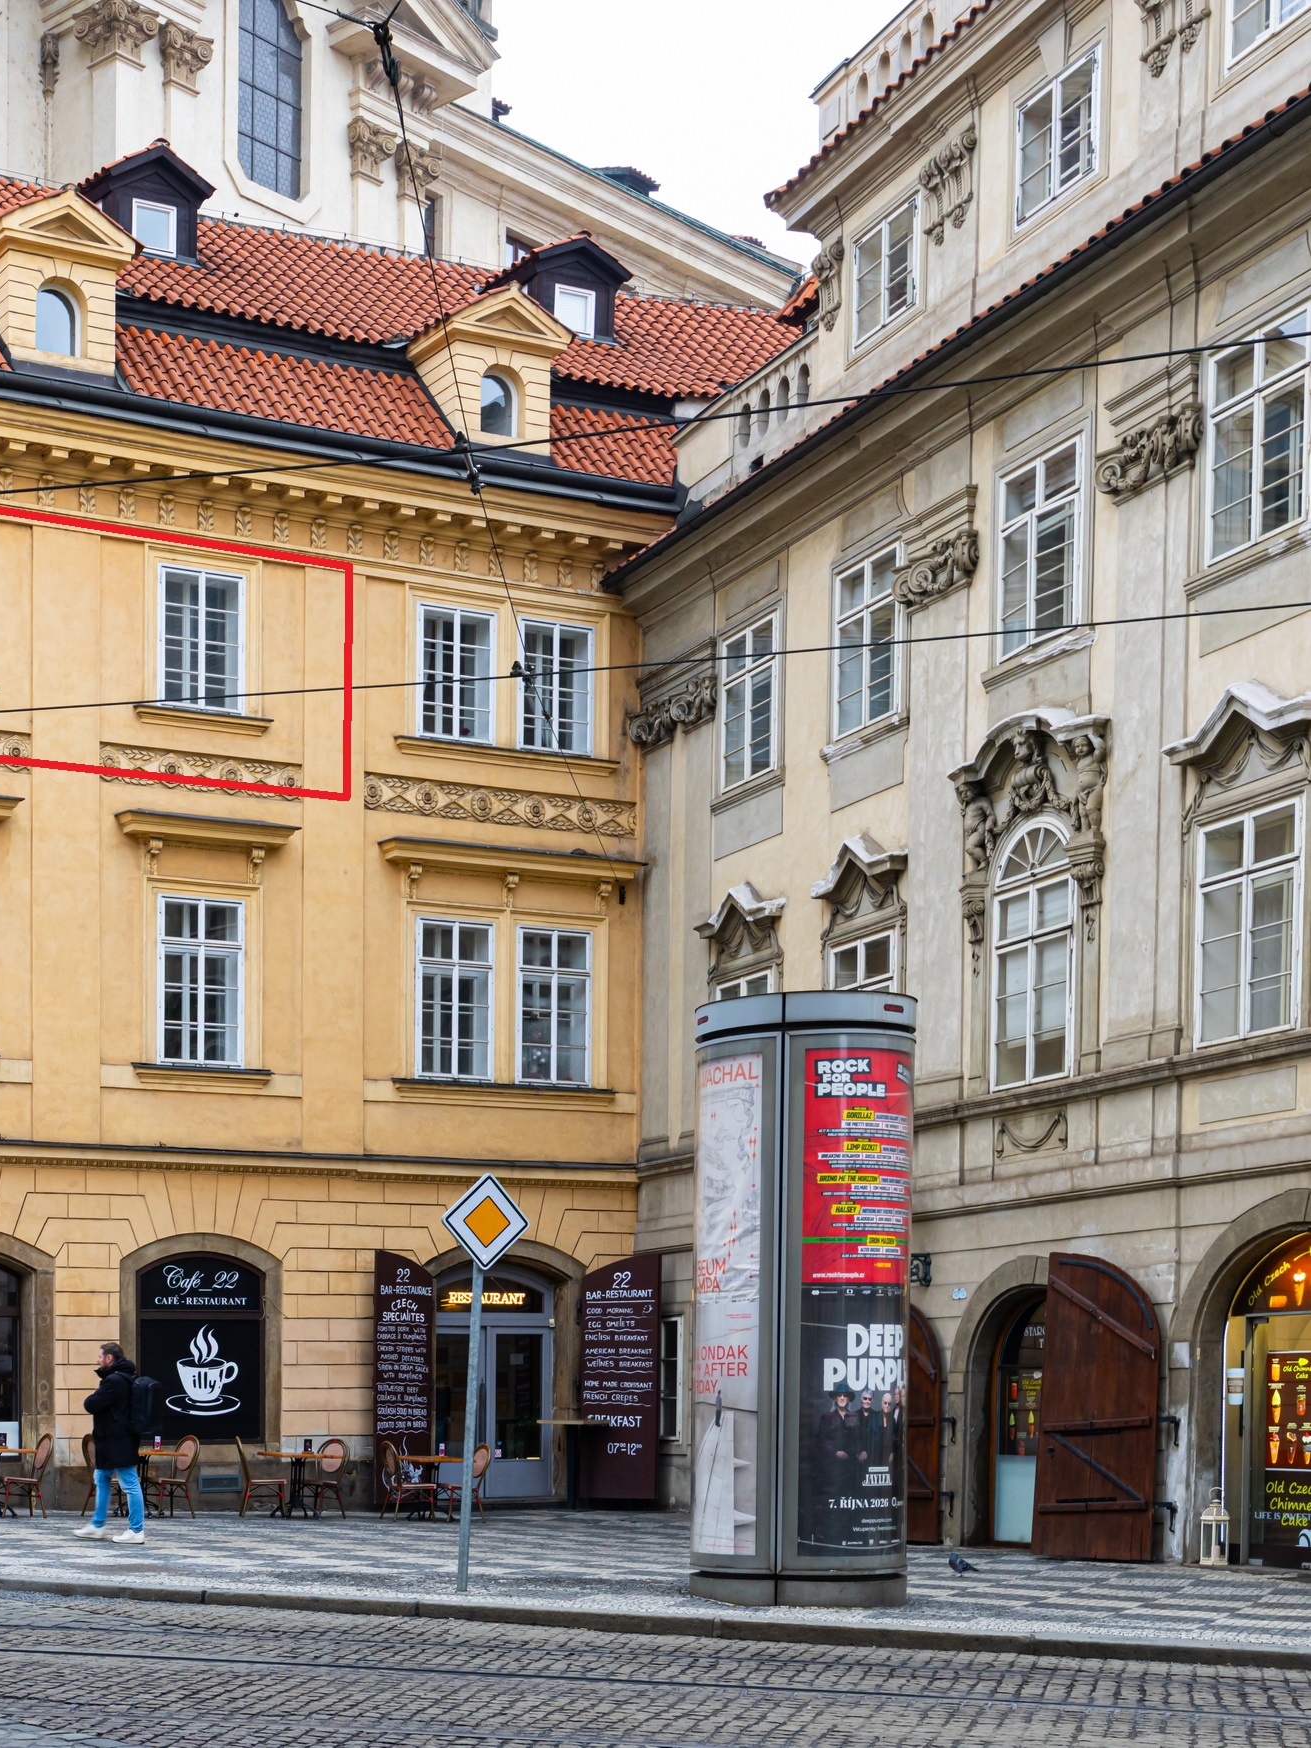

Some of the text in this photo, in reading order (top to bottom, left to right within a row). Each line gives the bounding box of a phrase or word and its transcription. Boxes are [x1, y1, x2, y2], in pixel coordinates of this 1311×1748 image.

[817, 1059, 870, 1074] ROCK
[822, 1073, 851, 1083] FOR
[817, 1083, 886, 1097] PEOPLE
[396, 1268, 410, 1283] 22
[612, 1271, 631, 1289] 22
[380, 1285, 432, 1296] BAR-RESTAURACE
[1248, 1261, 1291, 1306] Old Czech
[155, 1295, 247, 1306] CAFÉ RESTAURANT
[448, 1292, 526, 1305] RESAURANT
[586, 1289, 653, 1300] BAR-RESTAURANT
[391, 1299, 418, 1311] CZECH
[847, 1323, 903, 1356] DEEP
[701, 1345, 748, 1360] ONDAK
[704, 1362, 747, 1377] AFTER
[611, 1394, 638, 1403] CREPES
[1266, 1480, 1284, 1493] Old
[828, 1499, 837, 1508] 7.
[839, 1496, 869, 1510] ŘÍJNA
[870, 1498, 888, 1508] 2026
[1254, 1511, 1272, 1519] LIFE
[1281, 1513, 1308, 1527] Cake
